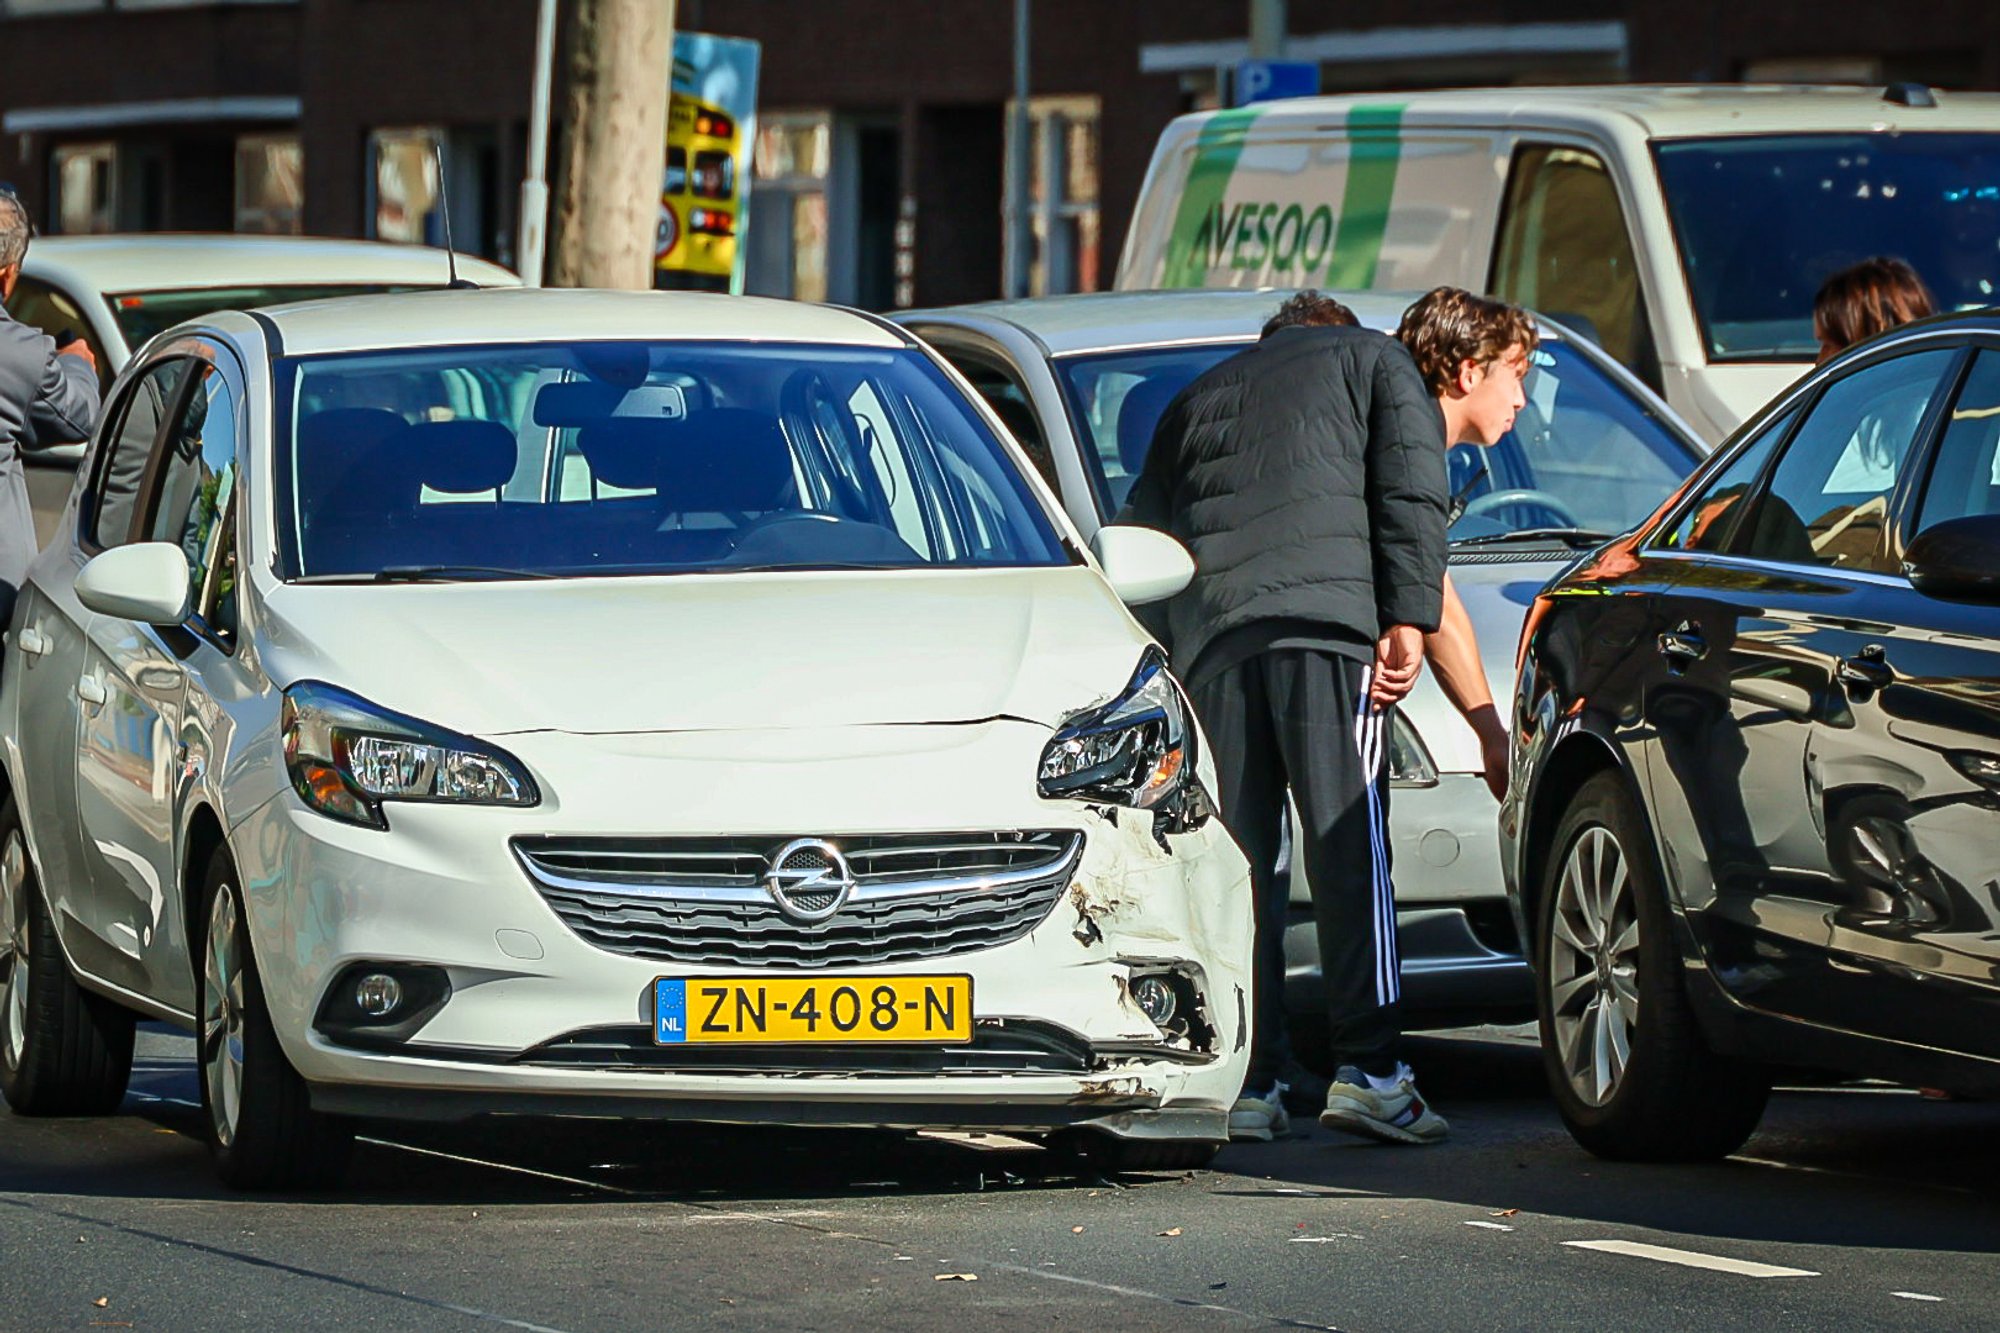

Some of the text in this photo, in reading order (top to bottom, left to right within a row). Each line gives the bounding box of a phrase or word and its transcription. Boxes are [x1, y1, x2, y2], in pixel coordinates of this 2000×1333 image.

[1242, 64, 1271, 102] P
[662, 1018, 682, 1032] NL
[700, 985, 955, 1032] ZN-408-N
